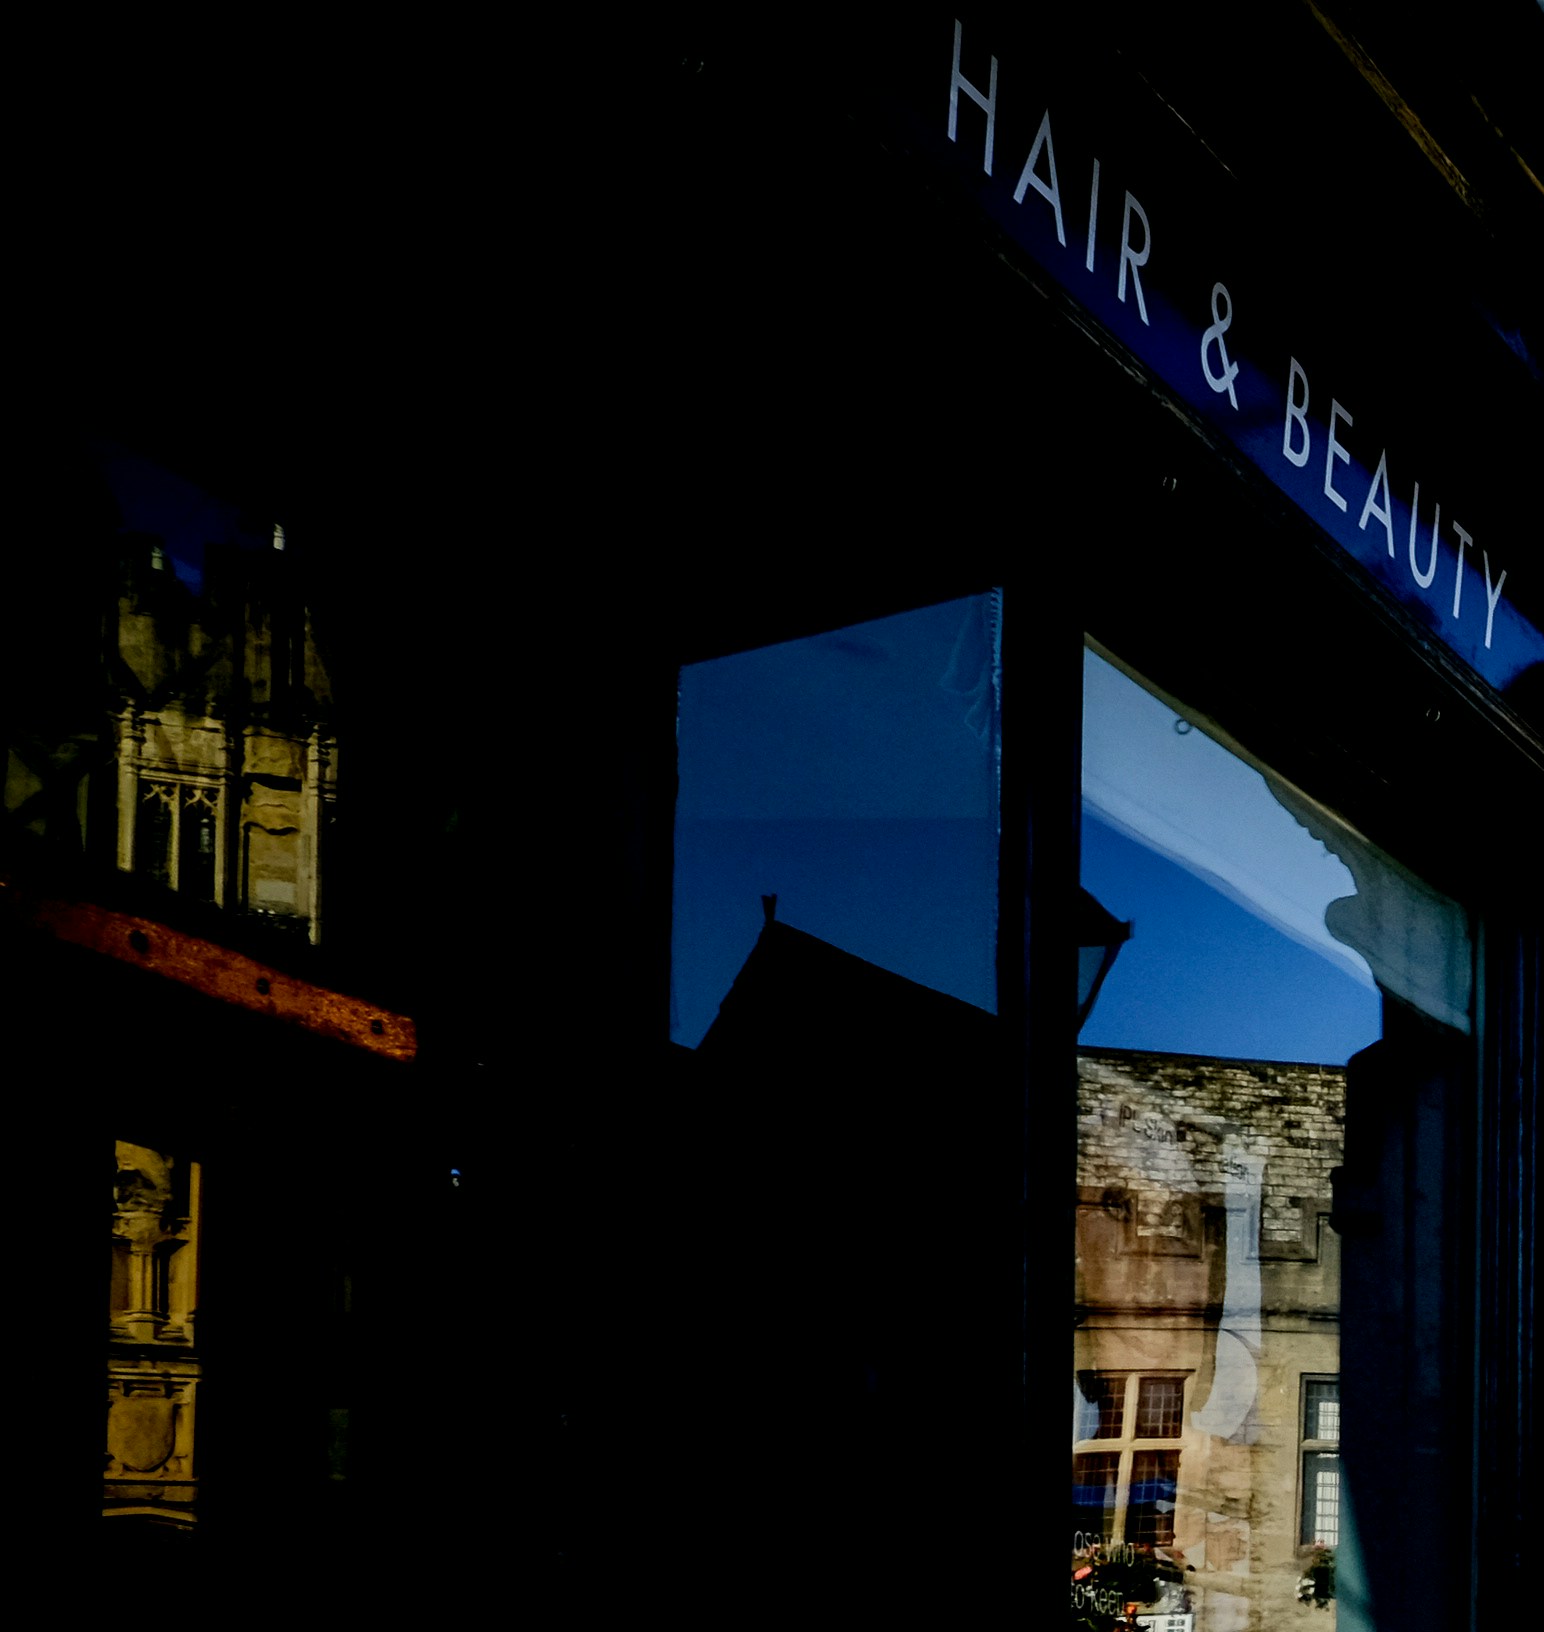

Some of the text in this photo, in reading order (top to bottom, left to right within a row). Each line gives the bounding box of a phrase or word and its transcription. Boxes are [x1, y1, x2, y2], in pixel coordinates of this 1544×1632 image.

[947, 18, 1508, 649] HAIR & BEAUTY
